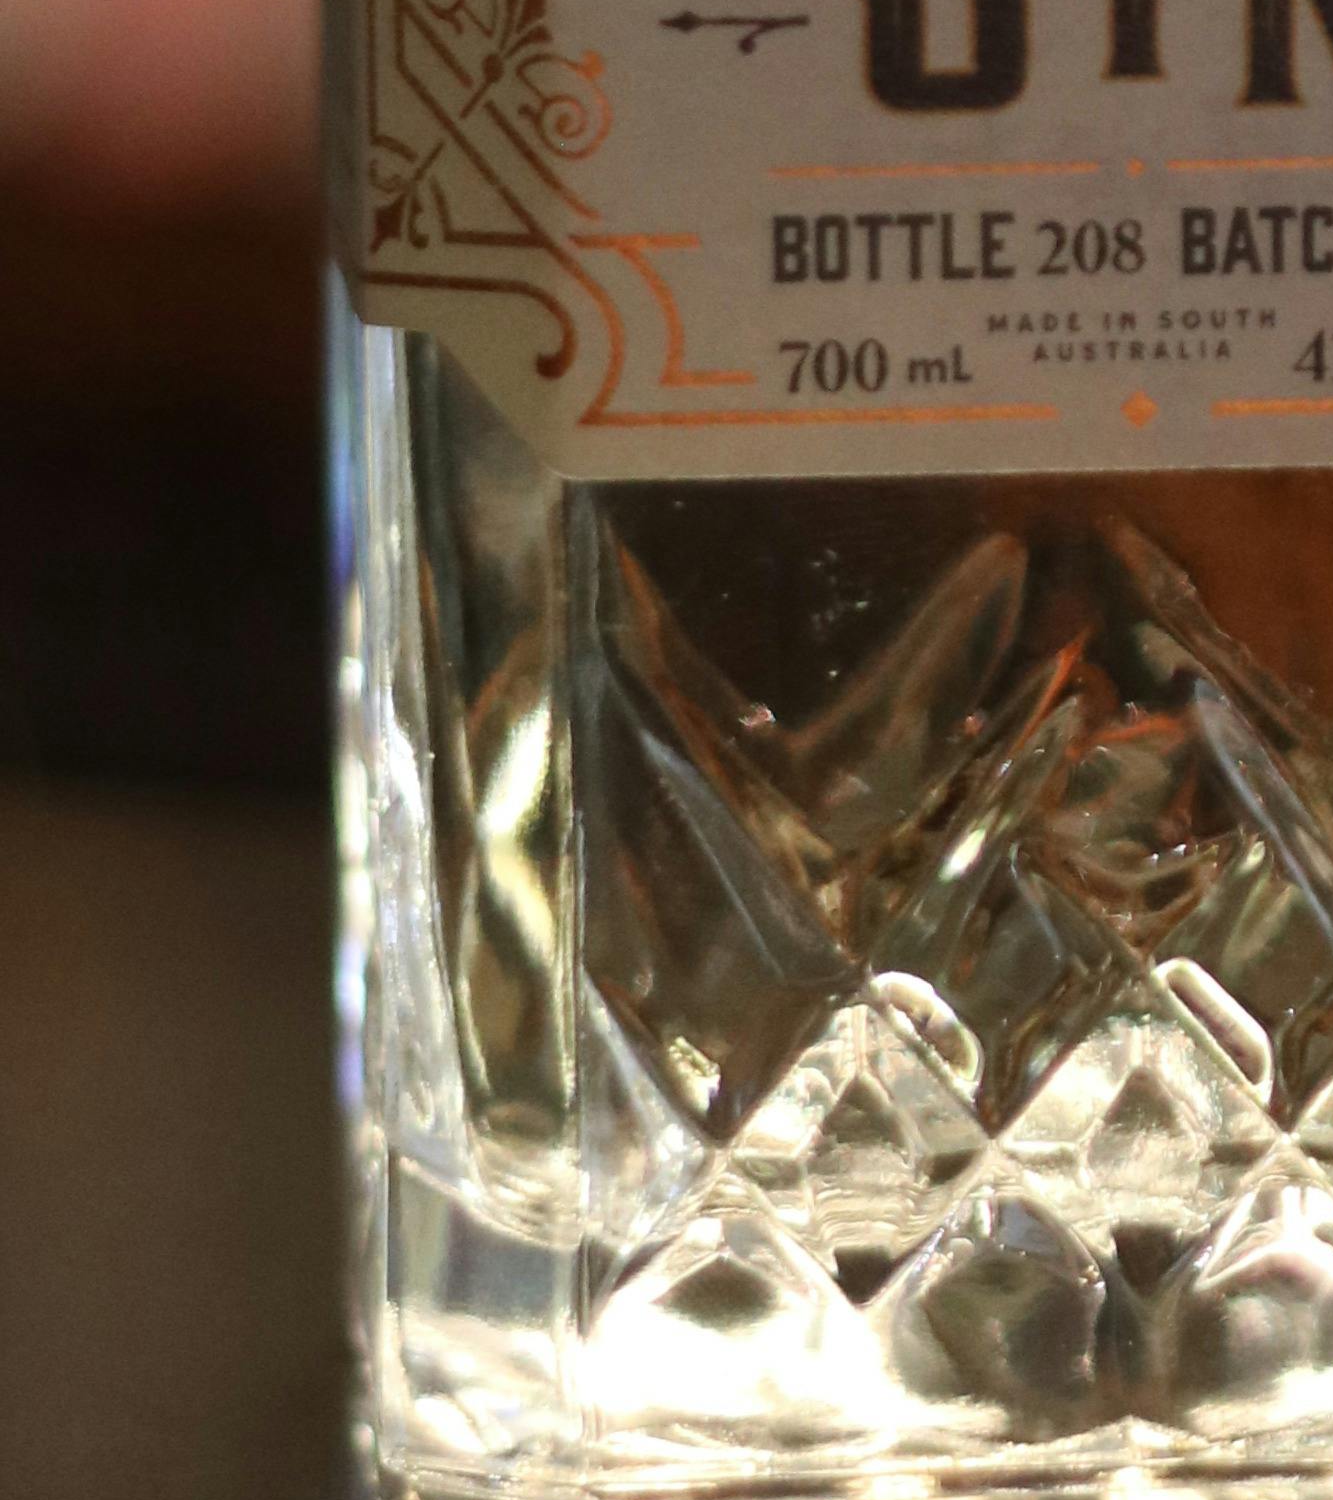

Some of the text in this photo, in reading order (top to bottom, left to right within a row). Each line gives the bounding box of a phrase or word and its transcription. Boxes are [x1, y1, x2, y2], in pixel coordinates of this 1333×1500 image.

[773, 210, 1016, 283] BOTTLE
[1036, 218, 1147, 276] 208
[987, 307, 1277, 333] MADE IN SOUTH
[778, 337, 973, 394] 700 mL
[1032, 339, 1231, 363] AUSTRALIA
